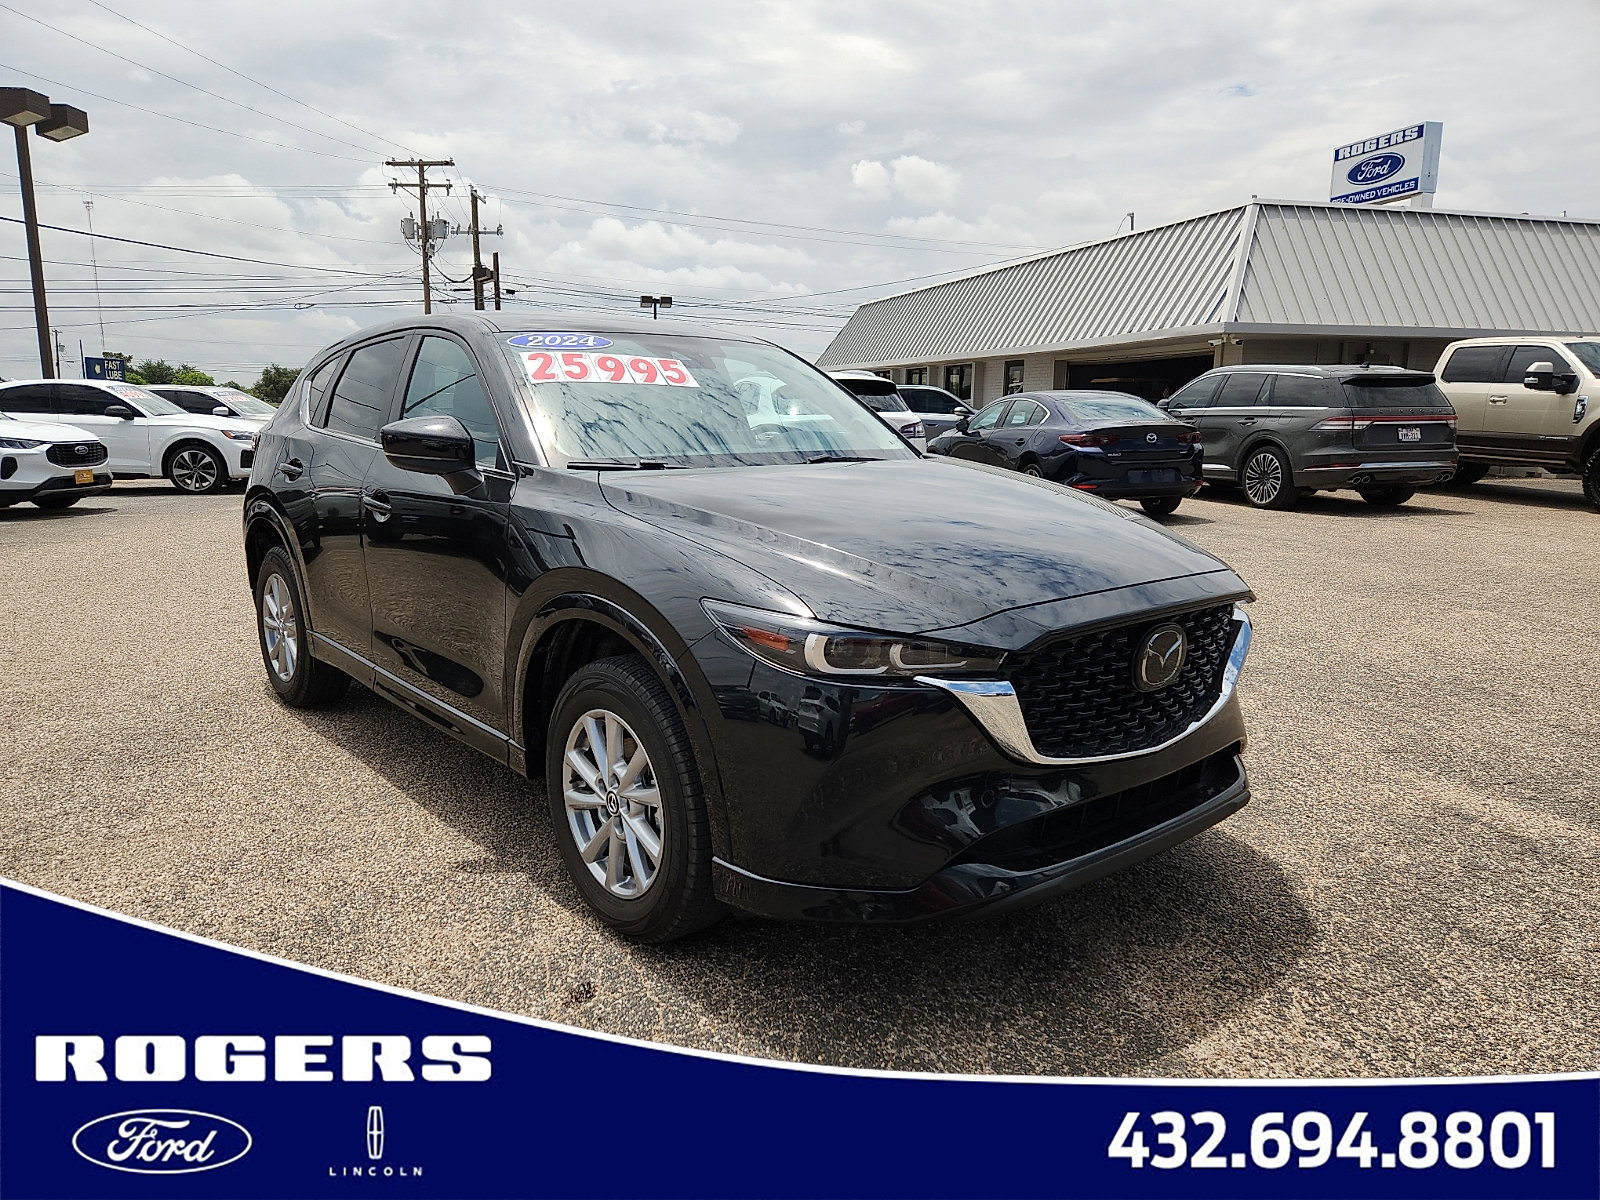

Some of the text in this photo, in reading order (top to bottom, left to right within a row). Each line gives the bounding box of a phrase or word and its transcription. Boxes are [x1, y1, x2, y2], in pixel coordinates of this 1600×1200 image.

[1338, 126, 1419, 160] ROGERS
[1357, 158, 1391, 181] Ford
[1377, 181, 1416, 197] VEHICLES
[527, 334, 597, 347] 2024
[104, 360, 121, 370] FAST
[527, 352, 690, 385] 25995
[105, 370, 123, 380] LUBE
